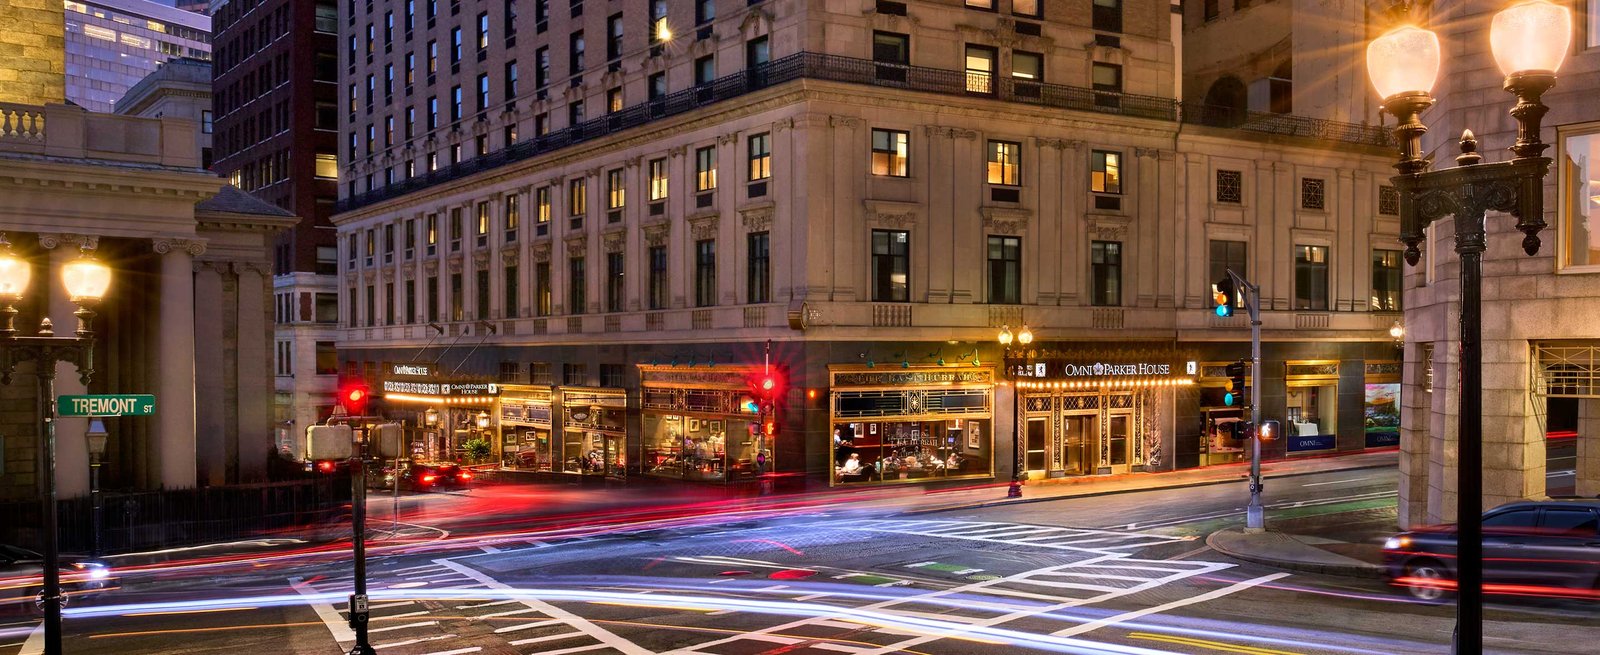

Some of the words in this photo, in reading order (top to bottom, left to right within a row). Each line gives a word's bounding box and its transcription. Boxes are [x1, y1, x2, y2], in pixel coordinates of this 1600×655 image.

[1065, 363, 1092, 376] OMNI
[1104, 363, 1137, 376] PARKER
[1138, 363, 1170, 375] HOUSE
[924, 374, 971, 382] HURRAH
[71, 398, 137, 413] TREMONT
[143, 405, 153, 413] ST
